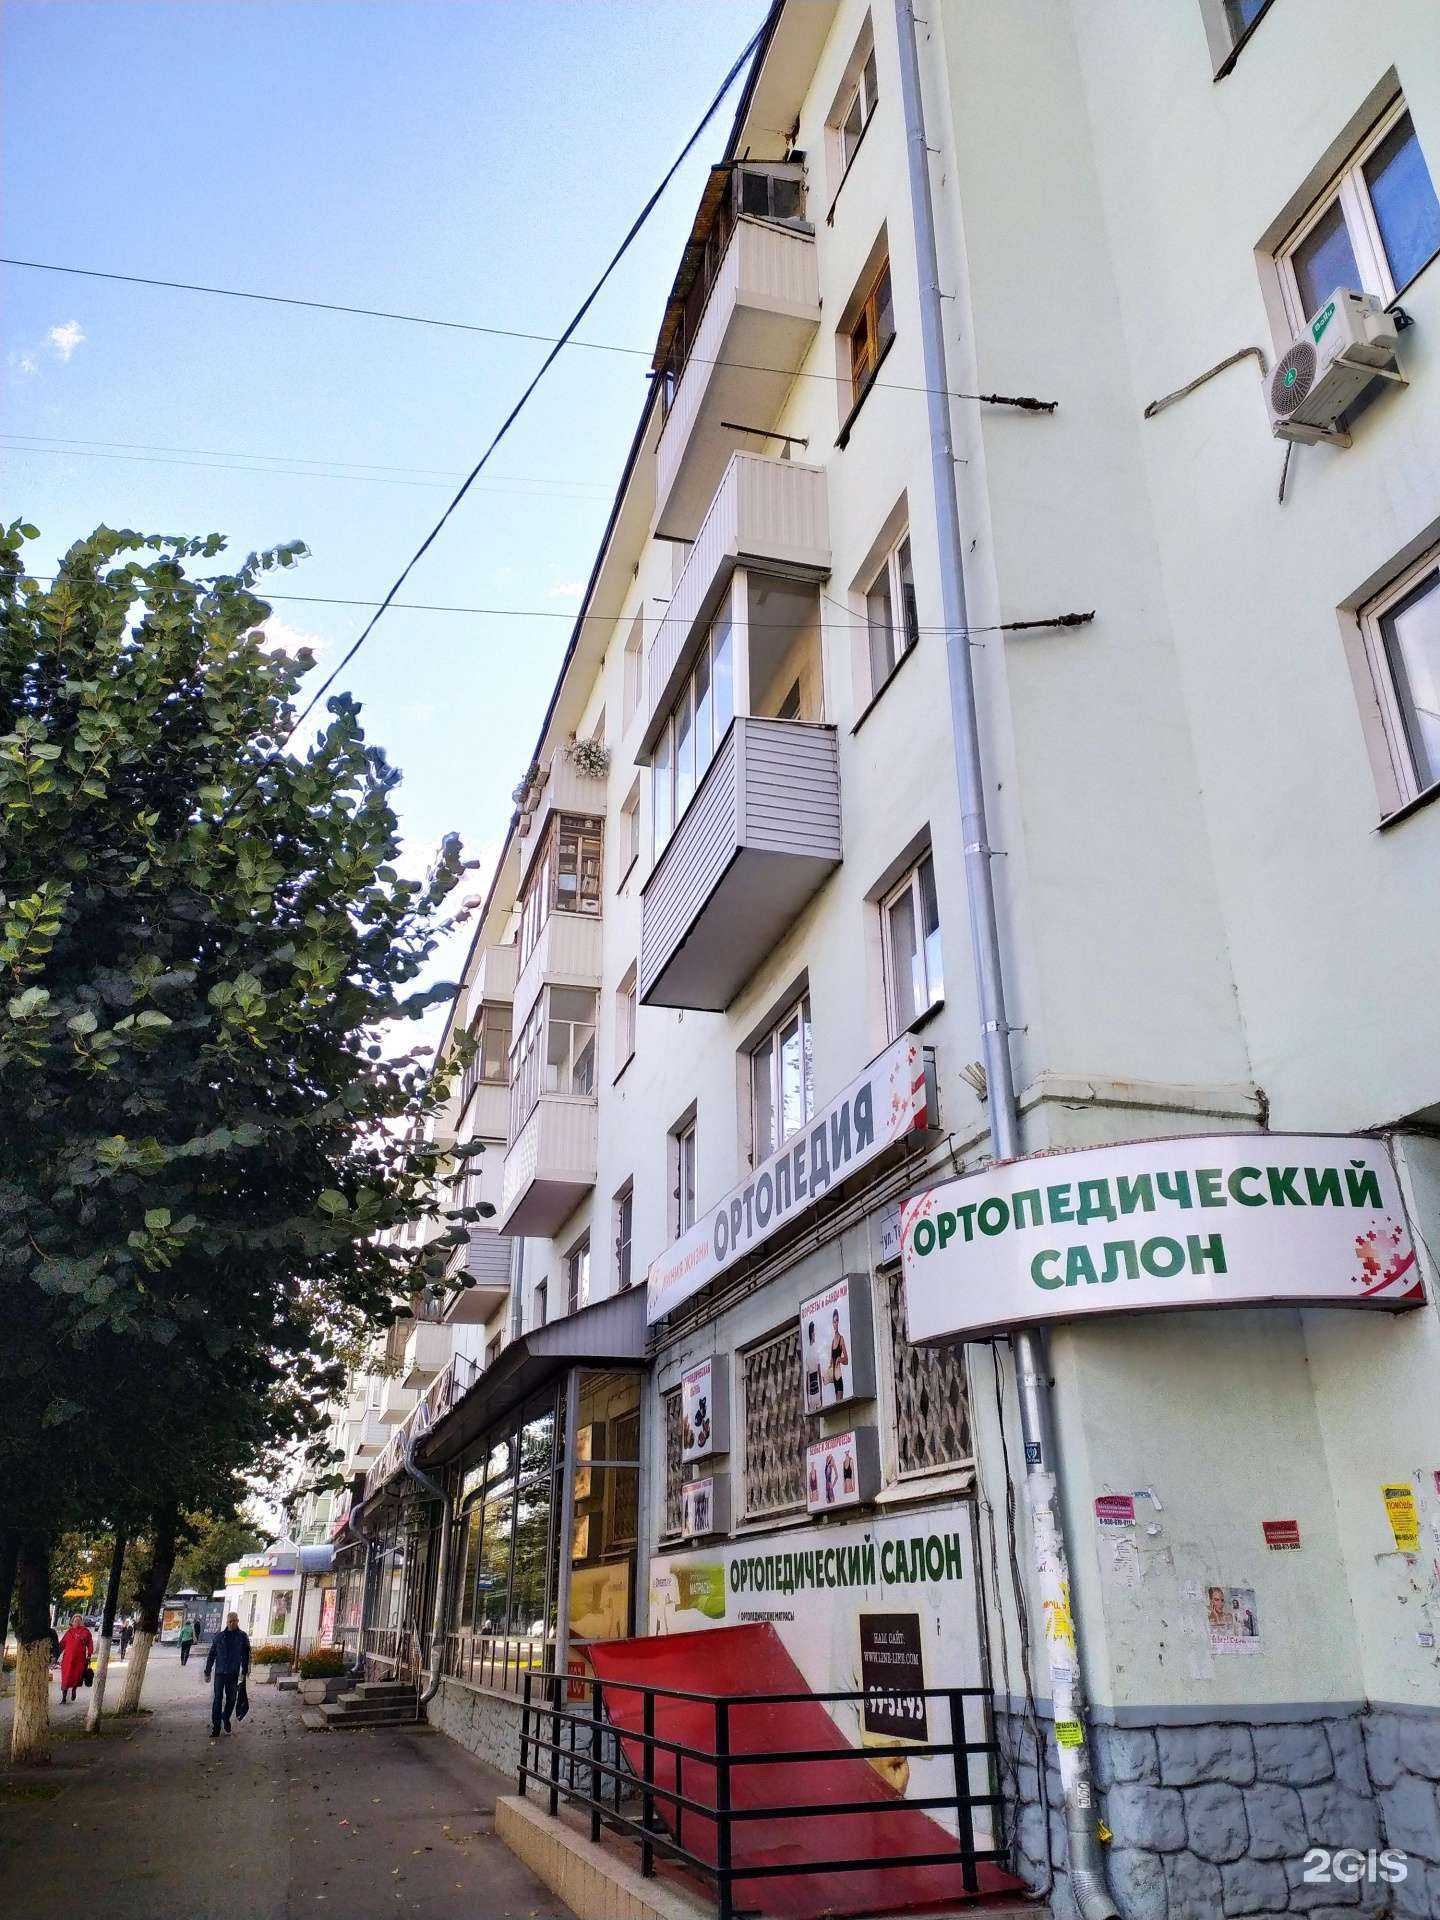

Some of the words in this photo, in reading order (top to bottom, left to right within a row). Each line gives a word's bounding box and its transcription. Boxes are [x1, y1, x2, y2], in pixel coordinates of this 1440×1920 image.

[714, 1081, 875, 1262] ОРТОПЕДИЯ
[913, 1160, 1384, 1258] ОРТОПЕДИЧЕСКИЙ
[1031, 1234, 1228, 1290] САЛОН
[730, 1534, 876, 1595] ОРТОПЕДИЧЕСКИЙ
[881, 1534, 963, 1585] САЛОН
